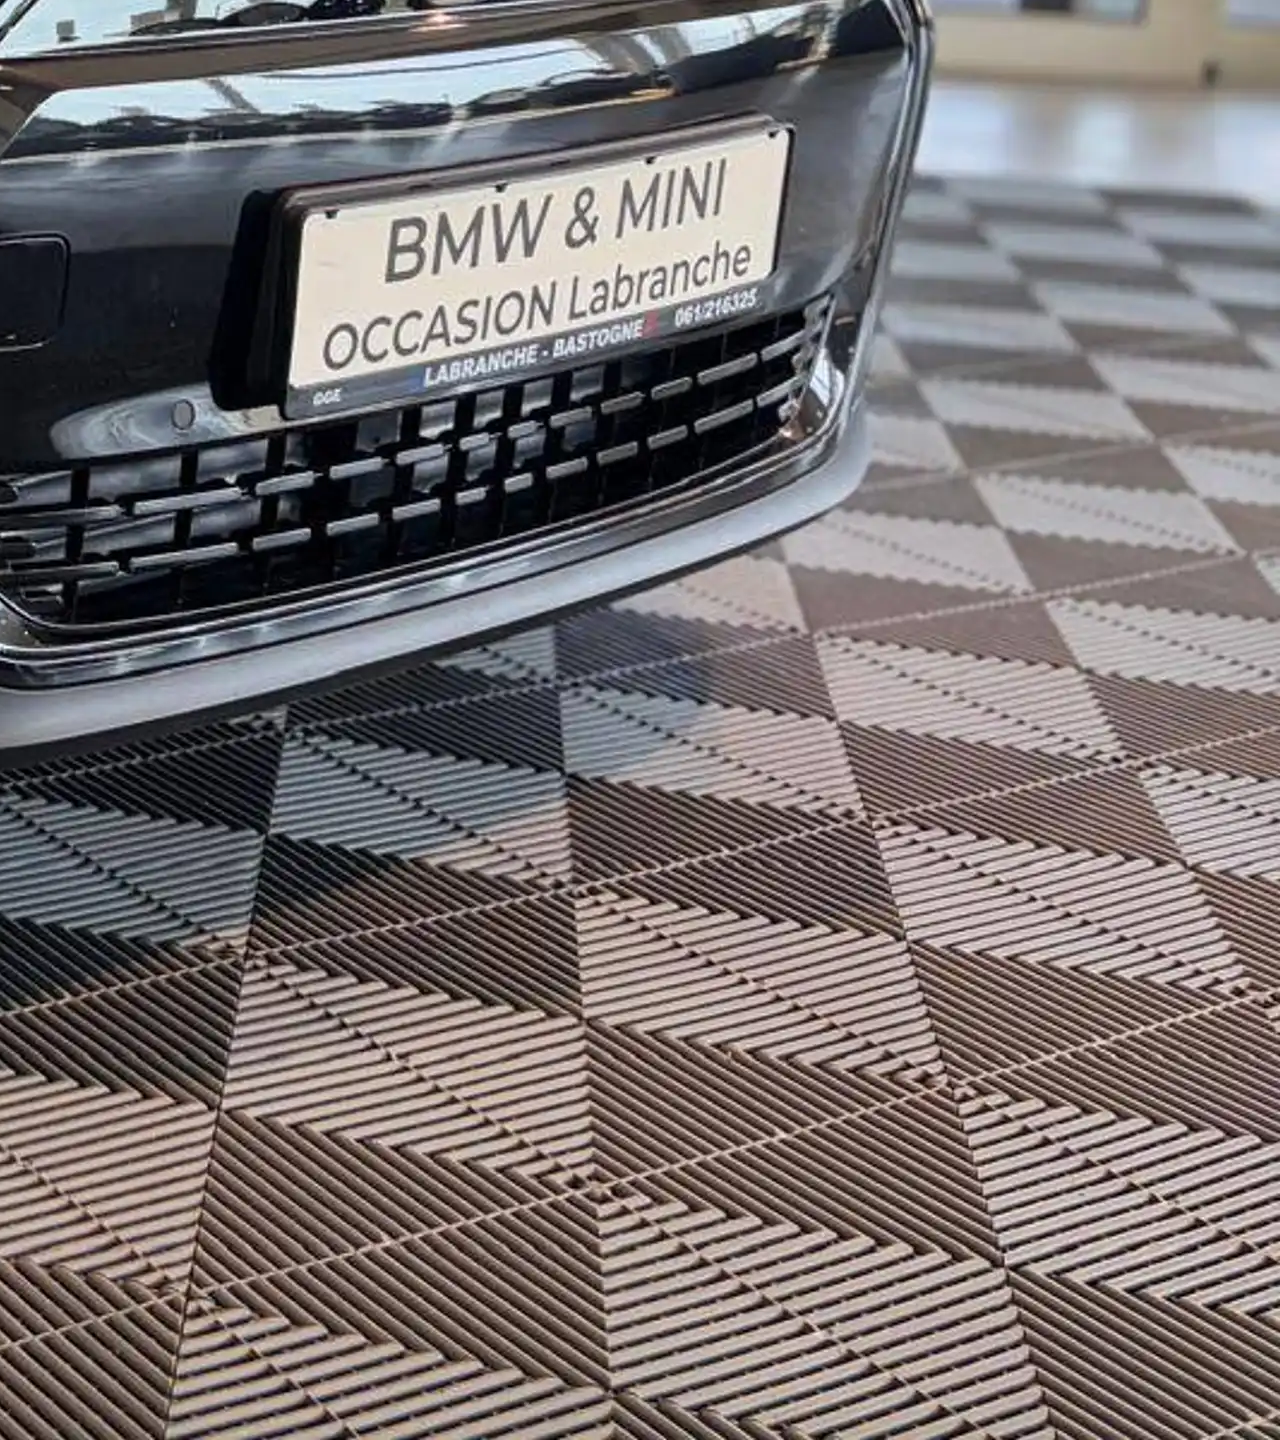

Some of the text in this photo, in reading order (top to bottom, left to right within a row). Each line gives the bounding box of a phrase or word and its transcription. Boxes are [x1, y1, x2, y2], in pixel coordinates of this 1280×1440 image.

[384, 158, 726, 284] BMW & MINI
[322, 240, 752, 370] OCCASION Labranche
[423, 343, 541, 388] LABRANCHE
[552, 319, 645, 358] BASTOGNE
